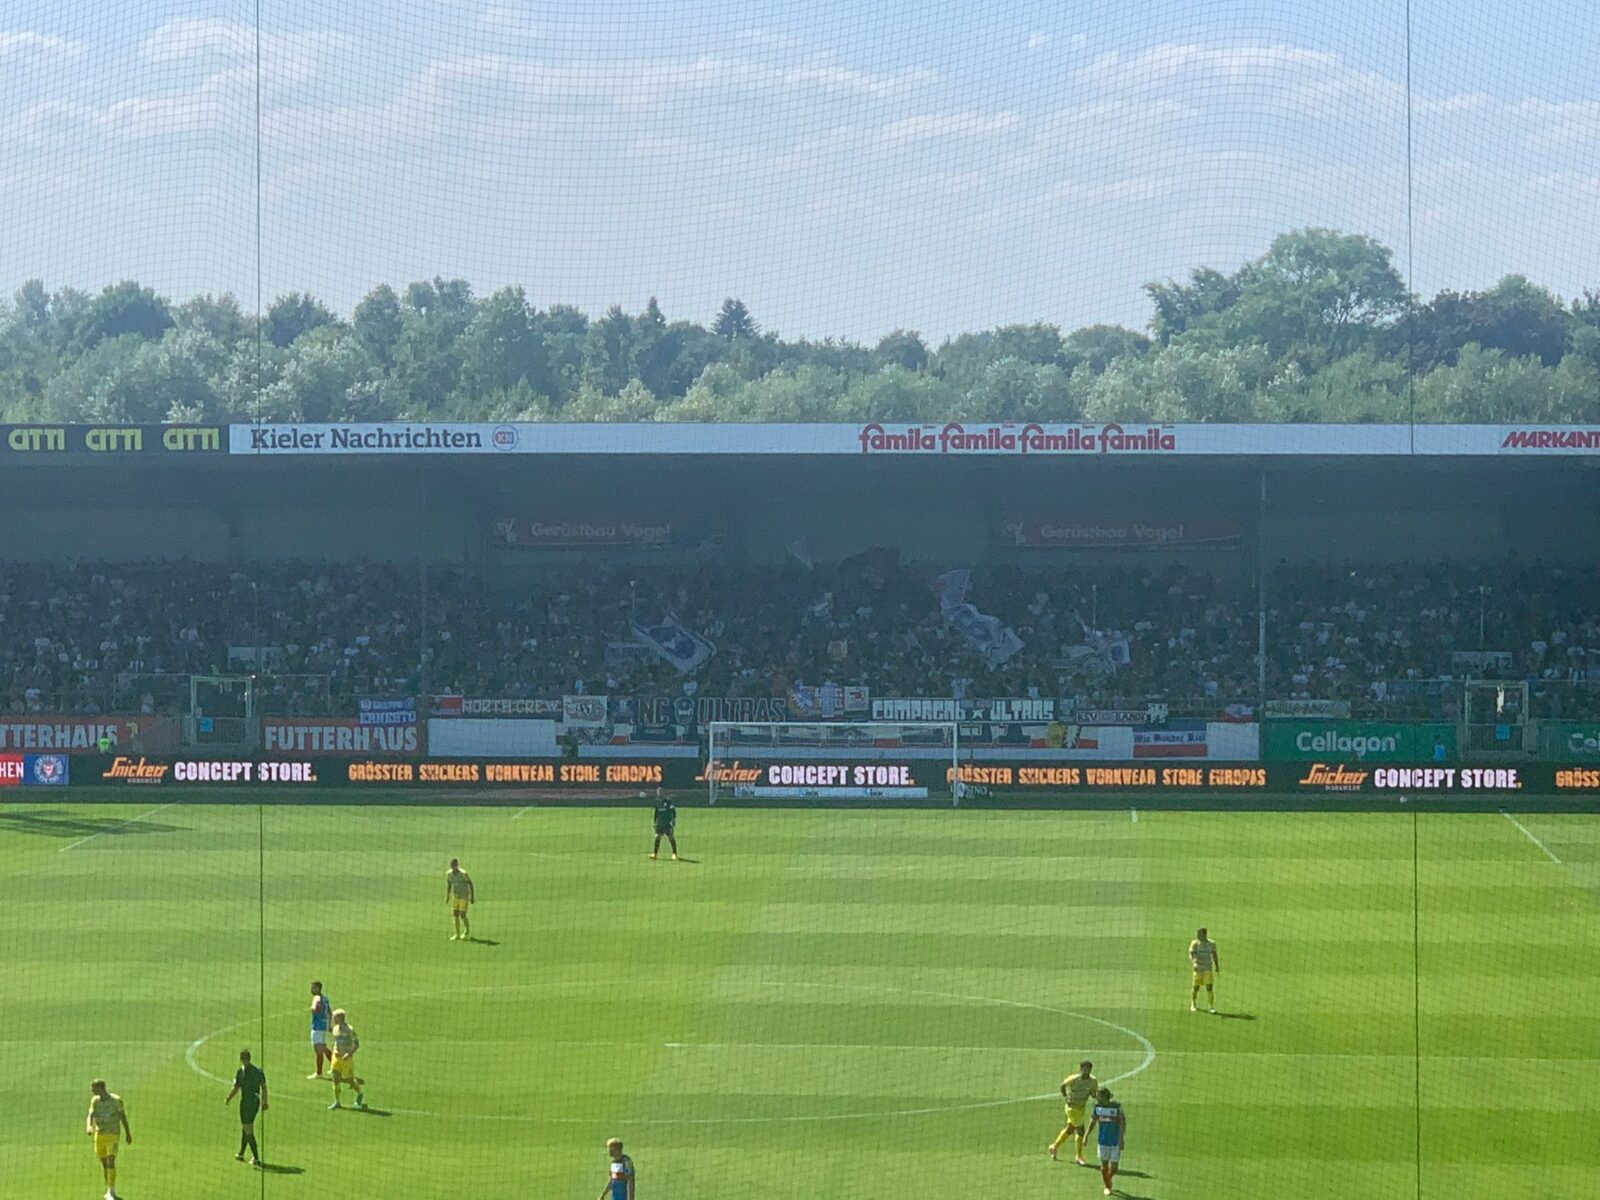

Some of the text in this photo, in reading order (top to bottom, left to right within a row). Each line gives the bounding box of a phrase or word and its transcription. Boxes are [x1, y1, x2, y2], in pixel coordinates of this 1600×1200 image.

[8, 428, 65, 450] CITTI
[85, 428, 142, 450] CITTI
[163, 428, 220, 450] CITTI
[250, 427, 482, 449] Kieler Nachrichten
[859, 423, 1175, 453] famila famila famila famila
[1501, 431, 1600, 448] MARKANT
[531, 522, 616, 538] Gerüstbau
[622, 522, 671, 540] Vogel
[1041, 523, 1127, 539] Gerüstbau
[1134, 523, 1185, 540] Vogel
[697, 698, 787, 723] ULTRAS
[990, 700, 1055, 720] ULTRAS
[264, 726, 418, 751] FUTTERHAUS
[1296, 730, 1396, 757] Cellagon
[174, 761, 317, 781] CONCEPT STORE.
[348, 761, 412, 781] GRÖSSTER
[485, 764, 554, 782] WORKWEAR
[560, 765, 600, 782] STORE
[606, 765, 662, 782] EUROPAS
[769, 765, 915, 785] CONCEPT STORE.
[946, 764, 1012, 785] GRÖSSTER
[1086, 768, 1156, 785] WORKWEAR
[1162, 768, 1203, 786] STORE
[1209, 768, 1266, 786] EUROPAS
[1374, 768, 1522, 788] CONCEPT STORE.
